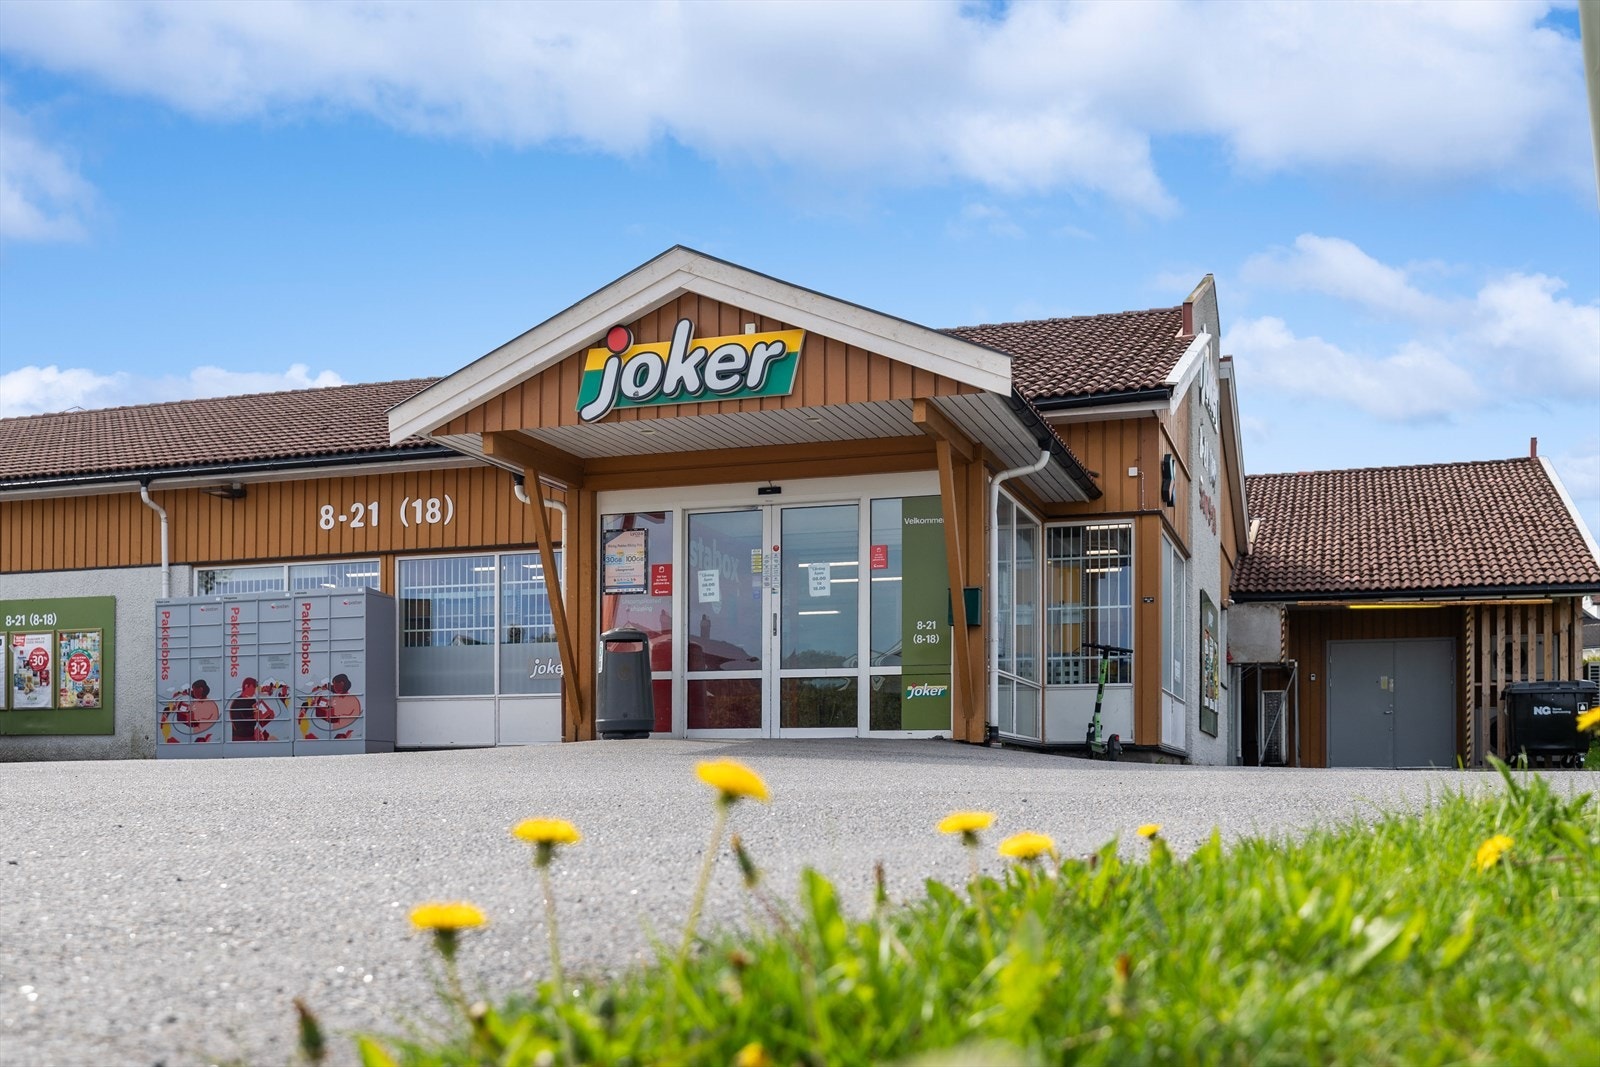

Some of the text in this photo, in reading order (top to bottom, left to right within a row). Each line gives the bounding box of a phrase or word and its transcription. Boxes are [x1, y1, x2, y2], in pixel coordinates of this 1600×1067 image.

[580, 318, 787, 423] joker
[319, 494, 454, 530] 8-21 (18)
[904, 517, 945, 525] Velkomme
[5, 612, 57, 626] 8-21 (8-18)
[916, 621, 936, 630] 8-21
[161, 611, 170, 680] Pakkeboks
[230, 607, 239, 677] Pakkeboks
[302, 602, 311, 675] Pakkeboks
[913, 634, 940, 644] (8-18)
[529, 658, 563, 679] joke
[907, 683, 945, 700] joker
[1533, 706, 1552, 715] NG
